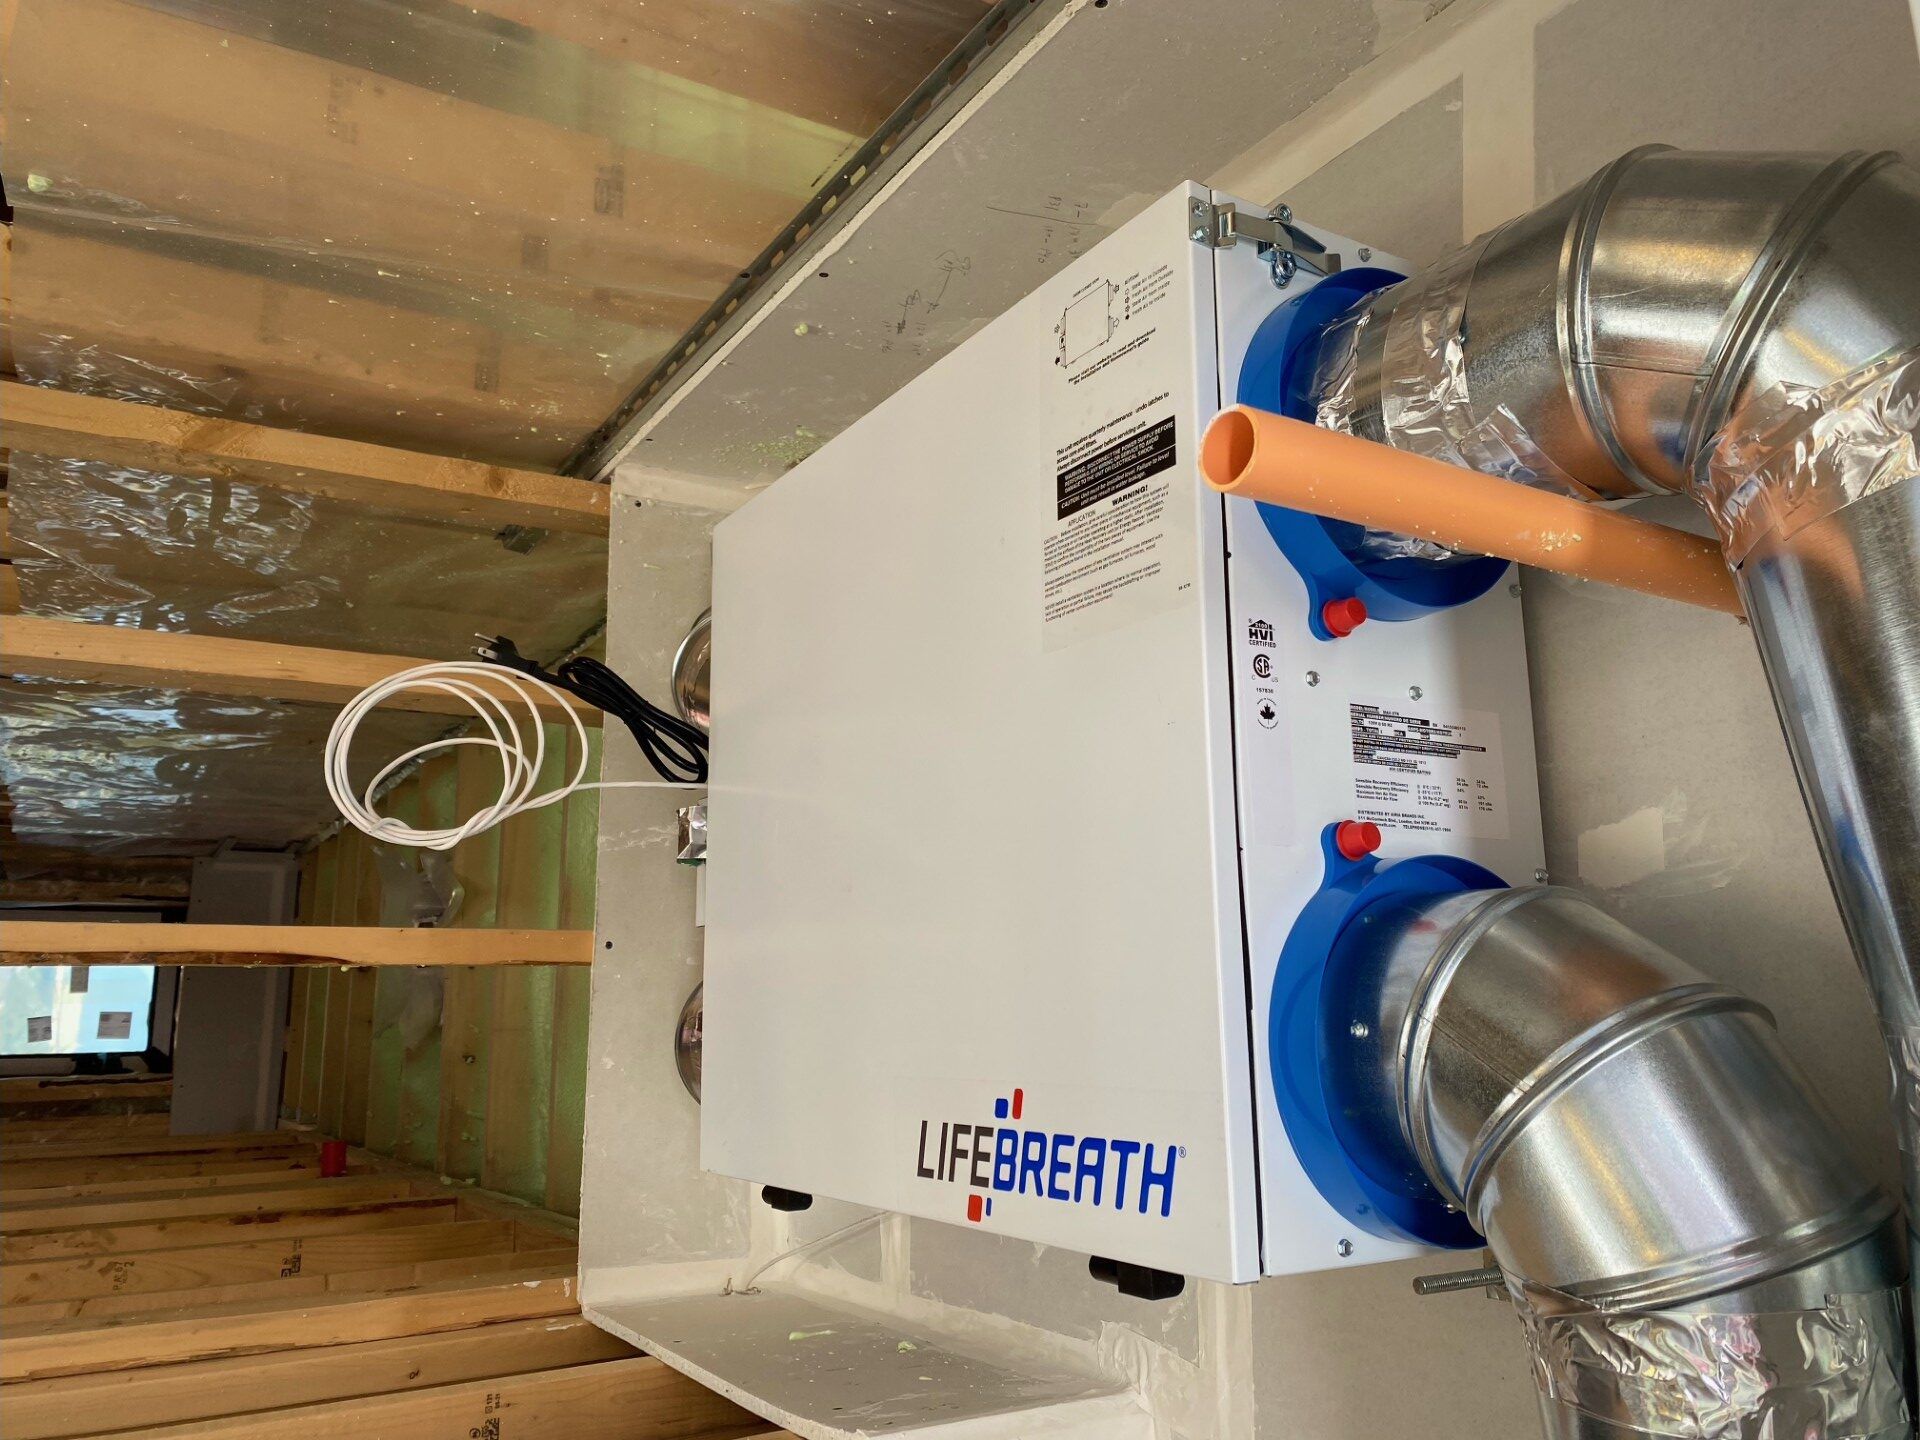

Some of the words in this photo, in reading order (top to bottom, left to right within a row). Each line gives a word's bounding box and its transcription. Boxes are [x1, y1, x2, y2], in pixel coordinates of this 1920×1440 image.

[1136, 327, 1155, 343] download
[1072, 434, 1087, 448] requires
[1088, 425, 1105, 439] quarterly
[1106, 410, 1132, 430] maintenance
[1136, 402, 1147, 414] undo
[1148, 394, 1162, 408] latches
[1163, 390, 1169, 399] to
[1121, 439, 1136, 452] POWER
[1137, 430, 1154, 444] SUPPLY
[1154, 420, 1173, 435] BEFORE
[1138, 441, 1145, 450] TO
[1145, 434, 1158, 446] AVOID
[1057, 459, 1069, 472] Always
[1070, 448, 1090, 465] disconnect
[1091, 442, 1103, 454] power
[1104, 435, 1116, 448] before
[1118, 425, 1135, 441] servicing
[1106, 473, 1124, 487] installed
[1136, 459, 1152, 473] Failure
[1152, 457, 1157, 465] to
[1158, 451, 1169, 463] level
[1112, 484, 1147, 506] WARNING!
[1068, 508, 1095, 526] APPLICATION
[1248, 629, 1273, 641] HVI
[1249, 640, 1276, 648] CERTIFIED
[916, 1120, 1178, 1217] LIFEBREATH
